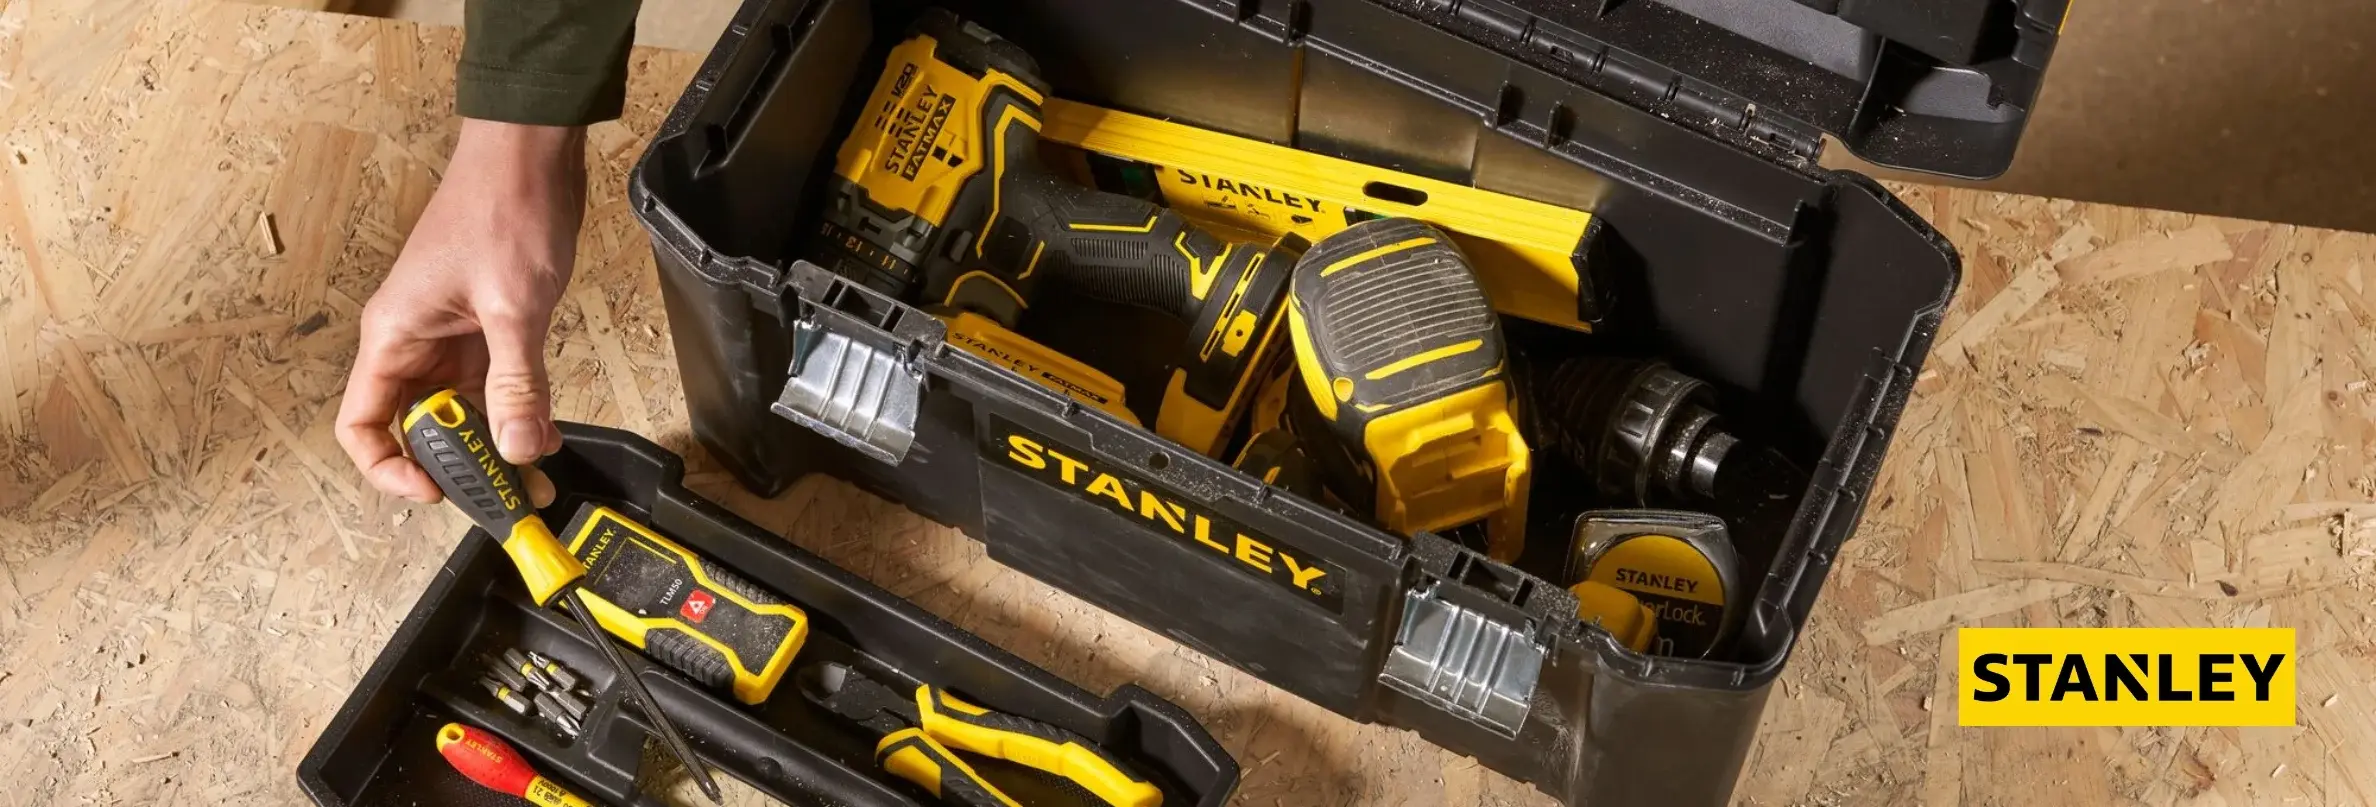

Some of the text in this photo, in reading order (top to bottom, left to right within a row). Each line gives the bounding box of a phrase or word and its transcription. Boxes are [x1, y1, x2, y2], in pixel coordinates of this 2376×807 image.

[884, 84, 939, 175] STANLEY
[903, 97, 954, 178] FATMAX
[953, 332, 1040, 372] STANLEY
[459, 428, 521, 510] STANLEY
[1007, 434, 1328, 590] STANLEY
[582, 528, 615, 573] TANLEY
[1615, 567, 1699, 594] STANLEY
[660, 578, 683, 606] TLM50
